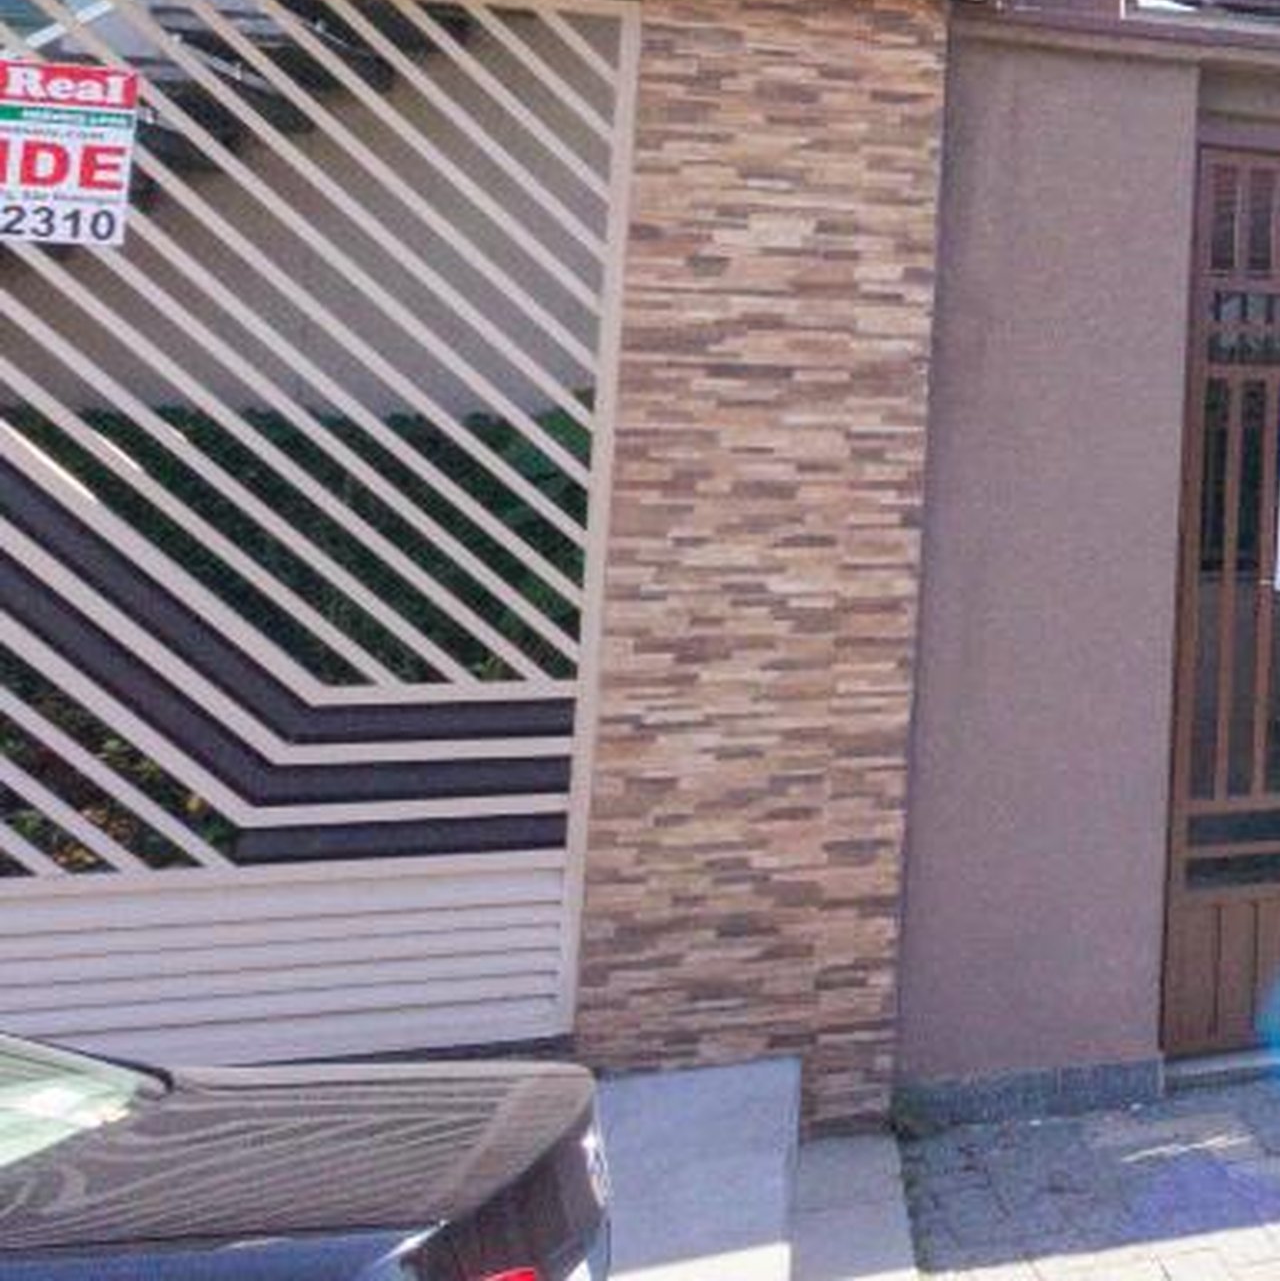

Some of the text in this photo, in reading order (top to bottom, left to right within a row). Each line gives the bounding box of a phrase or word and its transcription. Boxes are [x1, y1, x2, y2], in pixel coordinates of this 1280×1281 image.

[6, 66, 127, 105] Real
[0, 139, 126, 190] DE
[0, 205, 116, 240] 2310
